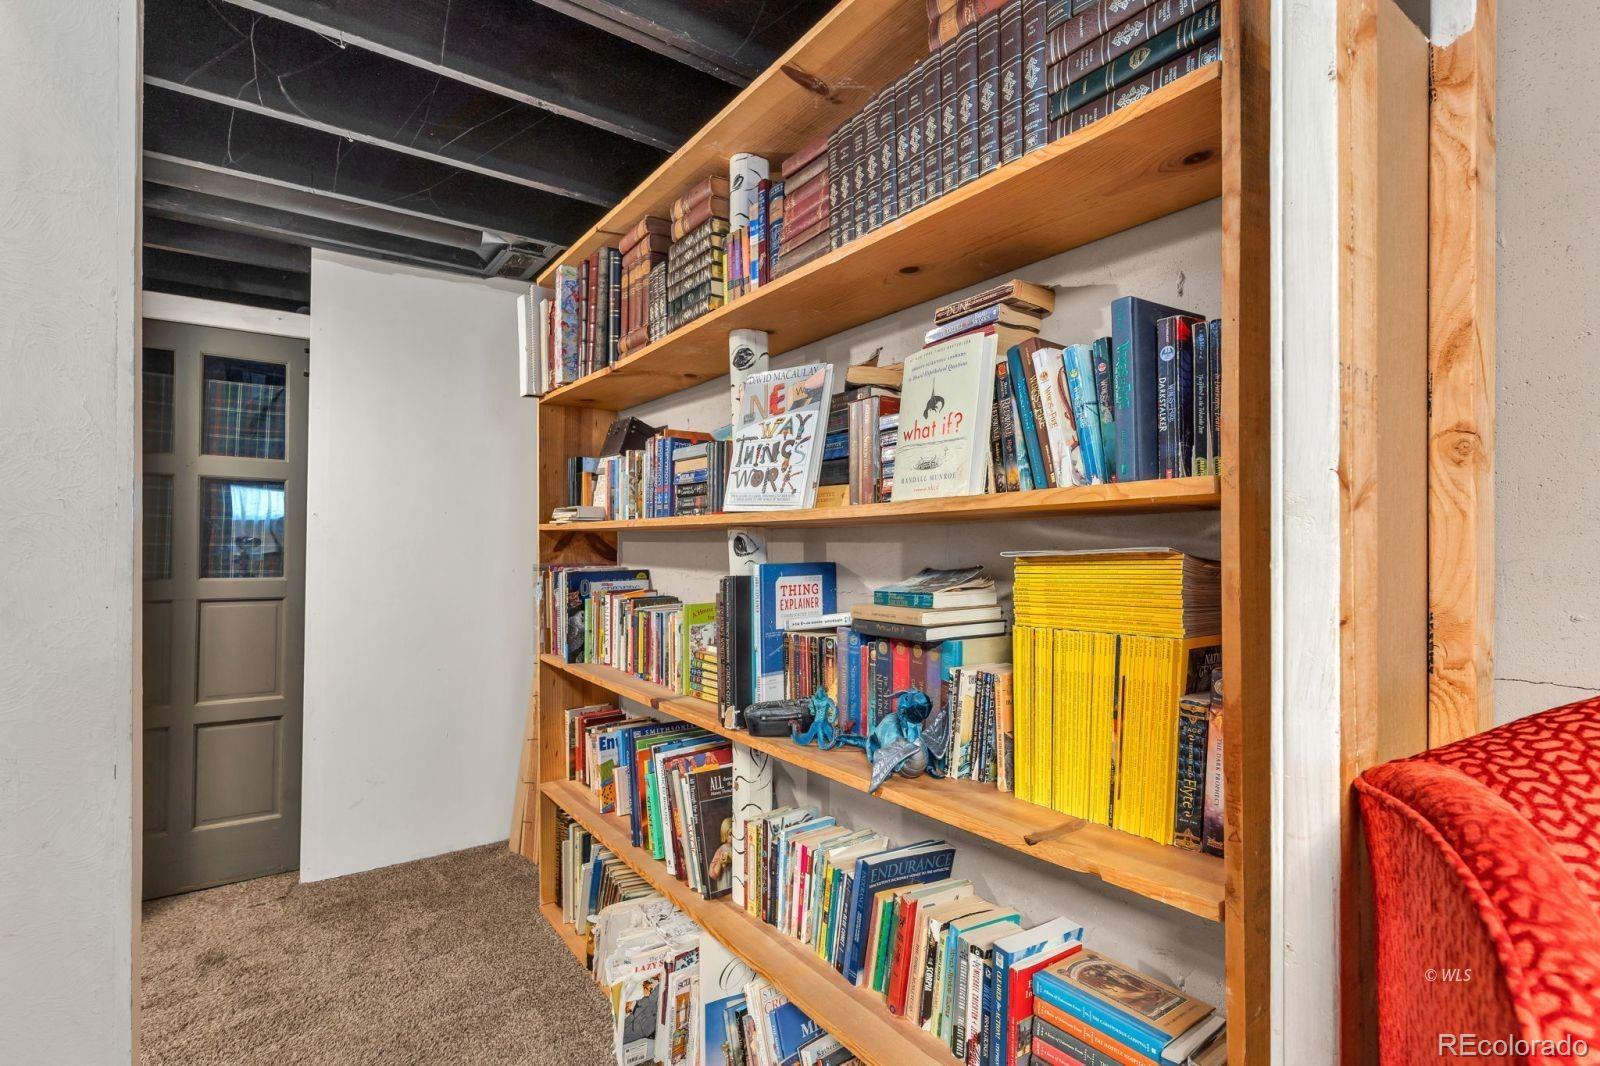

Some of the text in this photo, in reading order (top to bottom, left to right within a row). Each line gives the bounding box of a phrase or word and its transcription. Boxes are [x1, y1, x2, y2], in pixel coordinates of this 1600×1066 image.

[749, 373, 772, 385] DAVID
[1001, 397, 1014, 438] REDWALL
[1042, 383, 1059, 429] WINGS FIRE
[1158, 376, 1168, 432] DARKSTALKER
[758, 413, 813, 442] WAY
[903, 411, 964, 442] what if?
[735, 435, 812, 473] THINGS
[730, 466, 804, 495] WORK
[779, 596, 820, 611] EXPLAINER
[780, 583, 820, 597] THING
[876, 673, 885, 718] NEPTUNE
[710, 775, 724, 792] ALL
[1180, 777, 1198, 809] Flyte
[1213, 772, 1221, 807] PROPHECY
[870, 853, 953, 884] ENDURANCE
[634, 958, 658, 973] LAZY
[923, 962, 933, 993] SCORPIA
[969, 965, 982, 1021] MICHAEL CRICHTON
[994, 970, 1004, 1041] CLEARED for ACTION!
